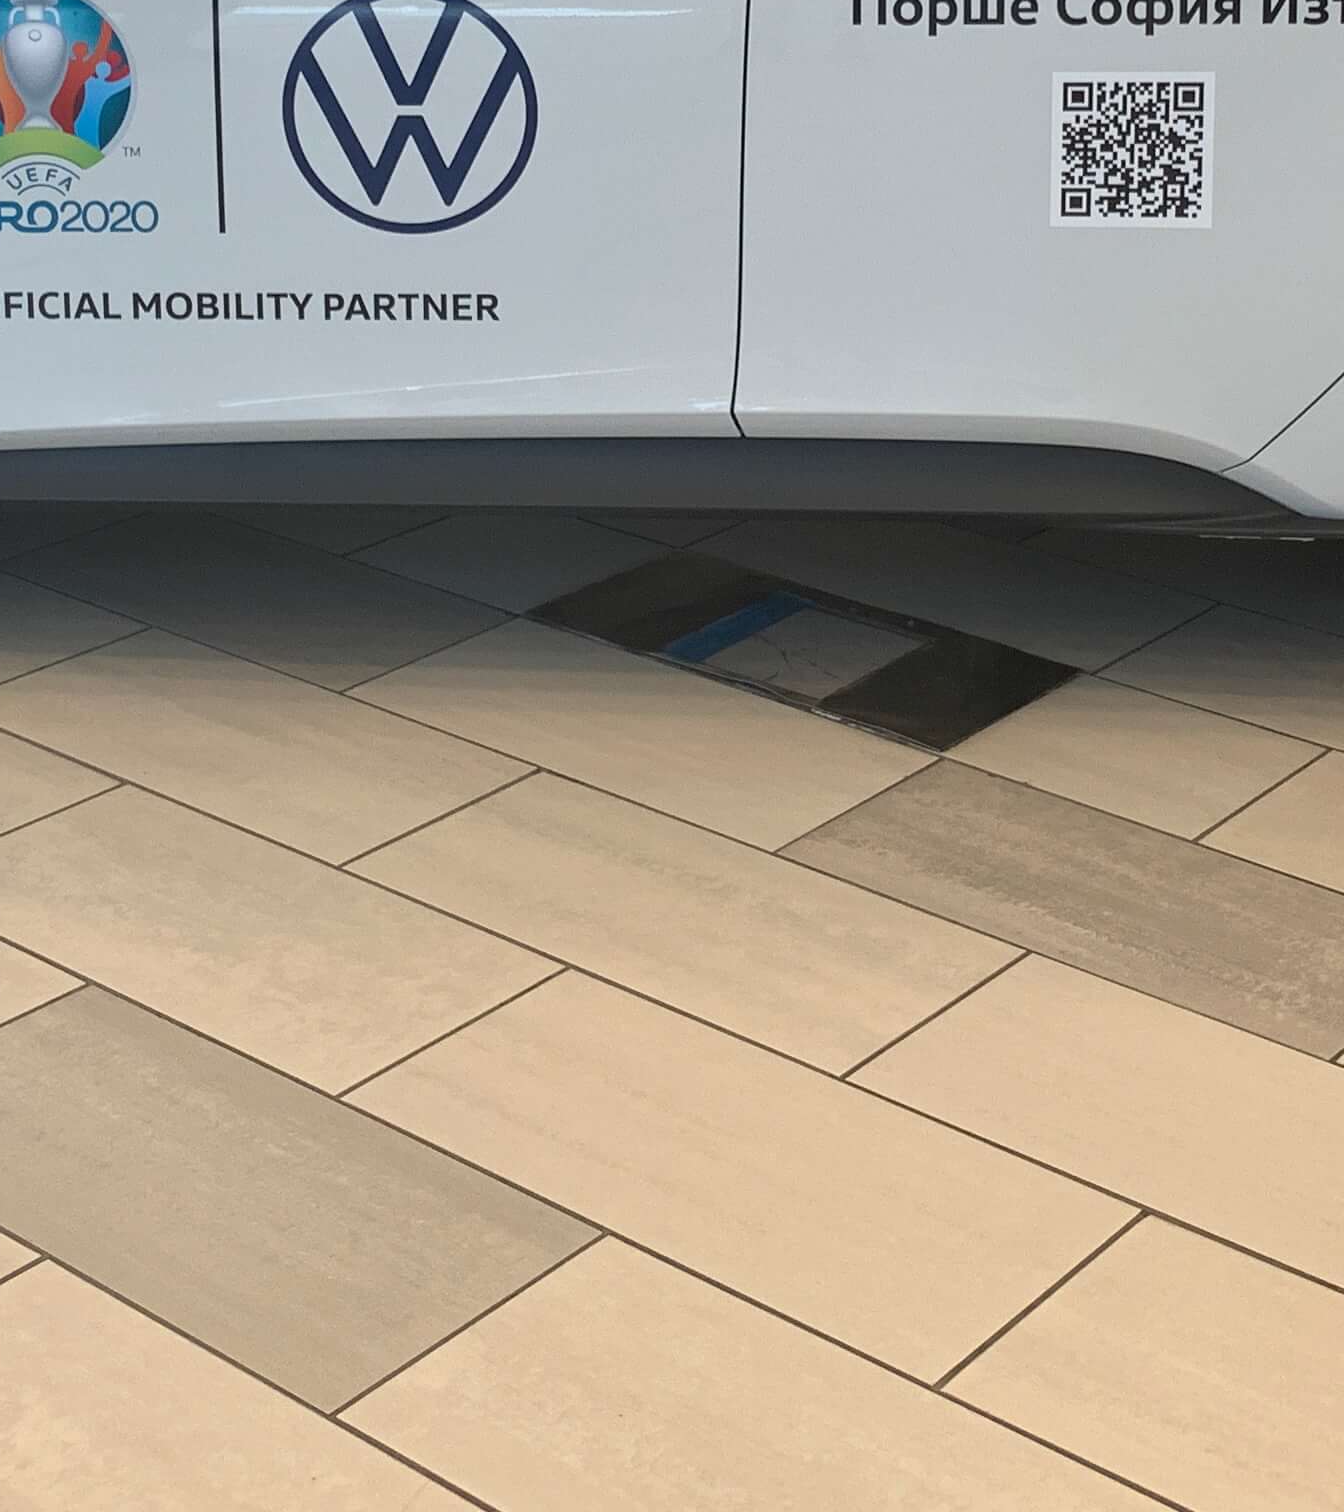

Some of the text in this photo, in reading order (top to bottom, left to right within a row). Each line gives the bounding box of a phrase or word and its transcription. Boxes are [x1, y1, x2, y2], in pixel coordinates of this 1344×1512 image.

[6, 167, 74, 192] UEFA
[132, 291, 314, 321] MOBILITY
[323, 292, 501, 322] PARTNER
